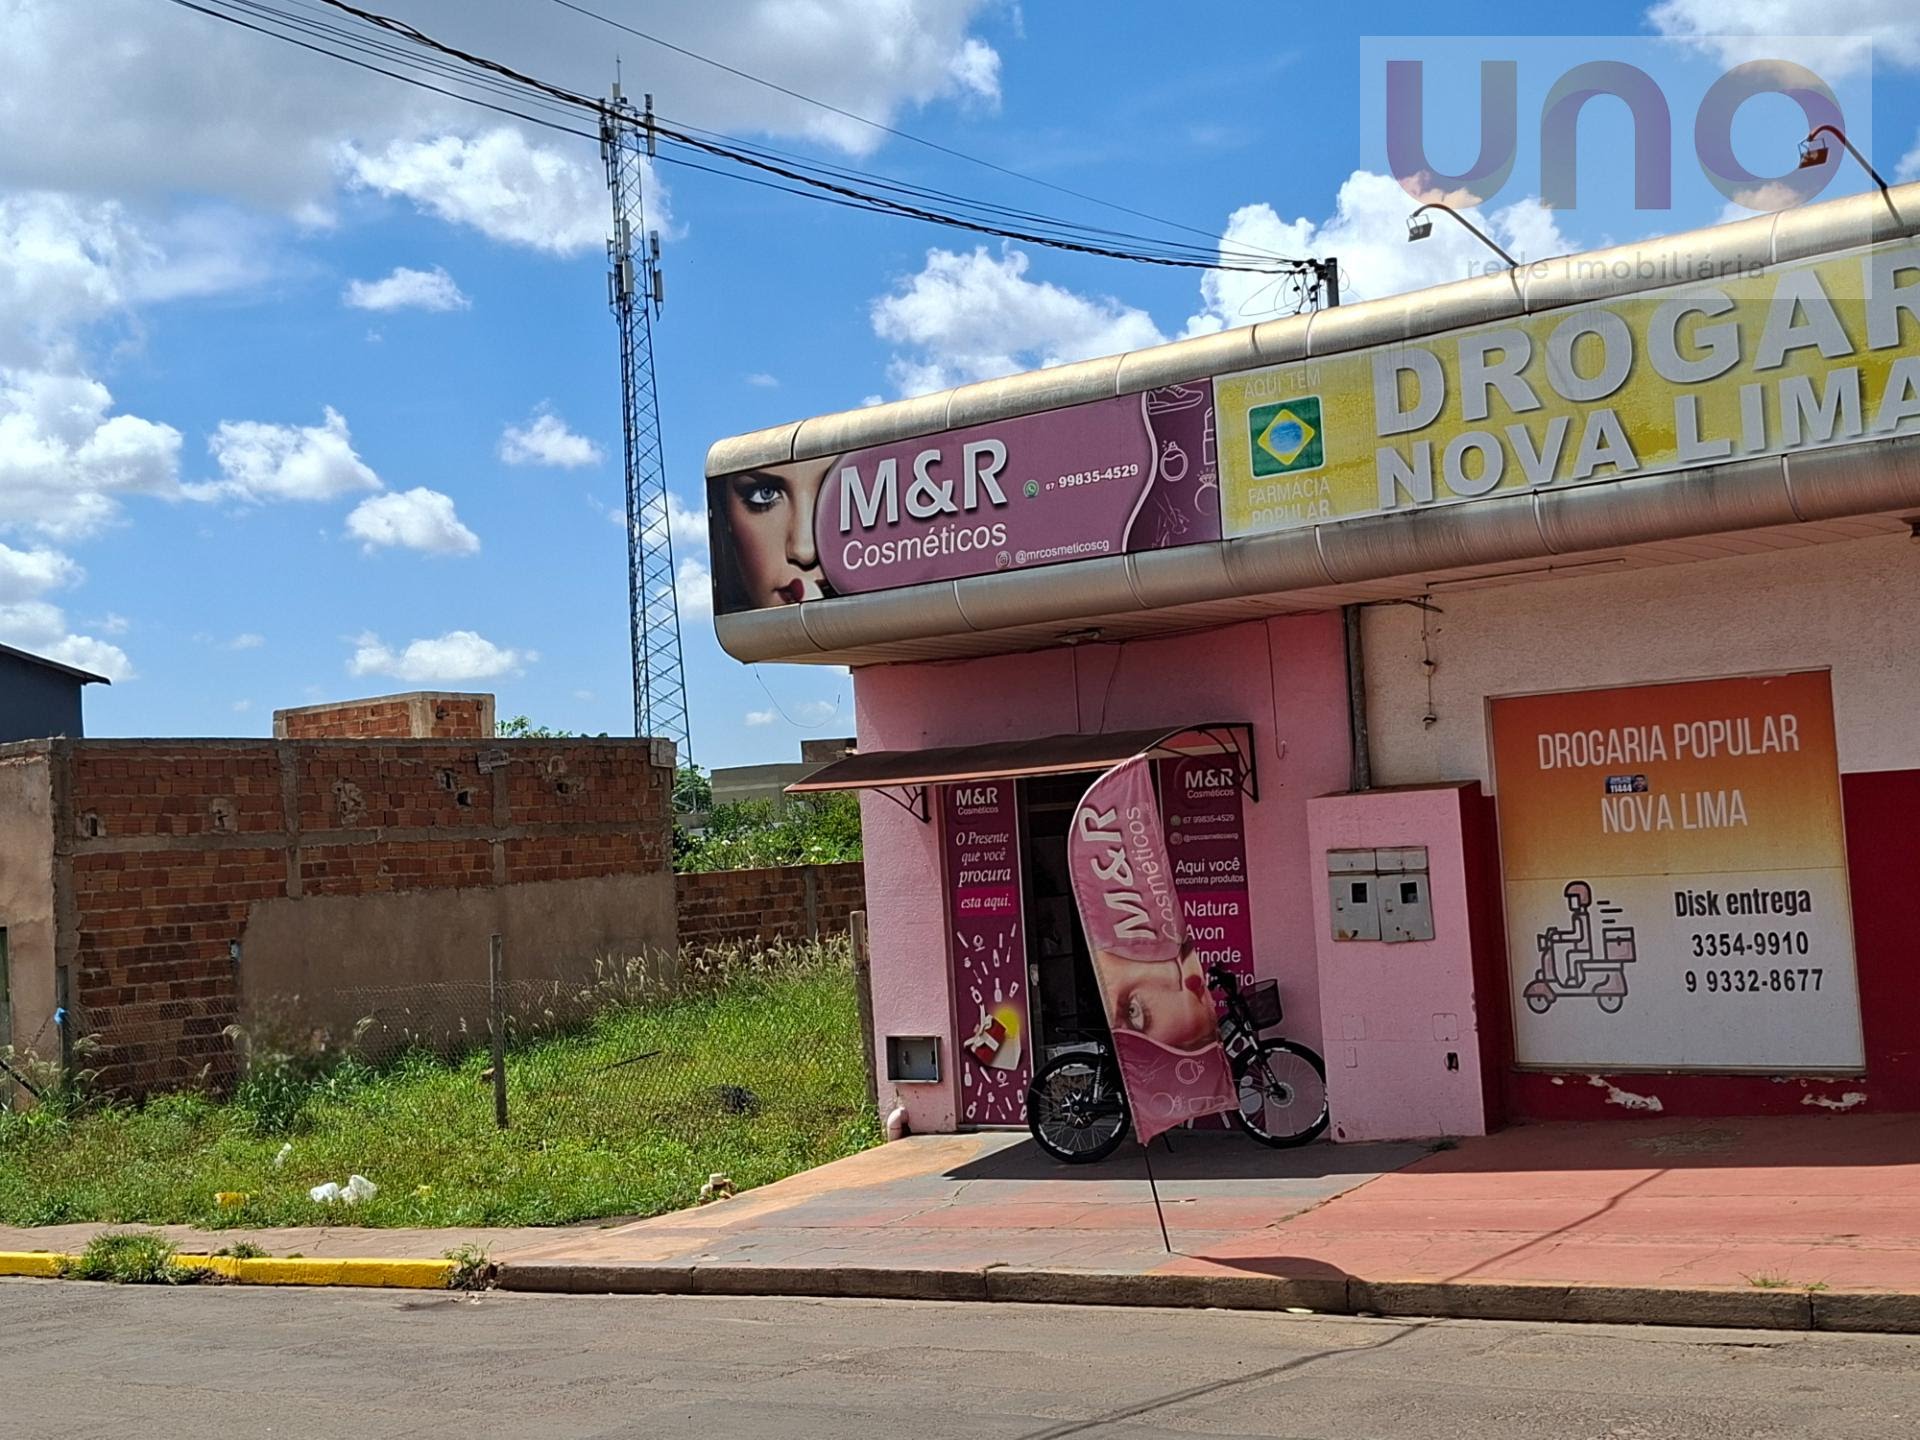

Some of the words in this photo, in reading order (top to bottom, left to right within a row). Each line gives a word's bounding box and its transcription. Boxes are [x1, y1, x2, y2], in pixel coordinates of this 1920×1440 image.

[1372, 250, 1920, 436] DROGAR
[1244, 375, 1281, 400] AQUI
[1285, 367, 1321, 391] TEM
[1377, 408, 1639, 509] NOVA
[1674, 356, 1920, 462] LIMA
[840, 439, 1008, 532] M&R
[1058, 464, 1139, 489] 99835-4529
[1248, 475, 1331, 505] FARMÁCIA
[1252, 498, 1331, 526] POPULAR
[843, 523, 1007, 570] Cosméticos
[1015, 539, 1110, 563] @mrcosmeticoscg
[1538, 725, 1668, 769] DROGARIA
[1673, 714, 1799, 760] POPULAR
[1185, 768, 1233, 788] M&R
[956, 787, 998, 807] M&R
[1187, 788, 1234, 799] Cosméticos
[957, 806, 999, 816] Cosméticos
[1601, 794, 1674, 833] NOVA
[1680, 789, 1748, 829] LIMA
[956, 831, 966, 846] O
[967, 831, 1009, 845] Presente
[961, 851, 980, 866] que
[983, 847, 1006, 861] você
[1175, 858, 1205, 875] Aqui
[1208, 857, 1240, 872] você
[958, 868, 1011, 888] procura
[1079, 807, 1157, 940] M&R
[1175, 875, 1208, 885] encontra
[1210, 874, 1244, 886] produtos
[961, 897, 981, 909] esta
[983, 893, 1011, 911] aqui.
[1184, 900, 1239, 917] Natura
[1674, 890, 1721, 917] Disk
[1726, 888, 1812, 917] entrega
[1186, 924, 1225, 940] Avon
[1691, 931, 1809, 957] 3354-9910
[1196, 947, 1242, 963] inode
[1685, 971, 1697, 993] 9
[1706, 968, 1823, 993] 9332-8677
